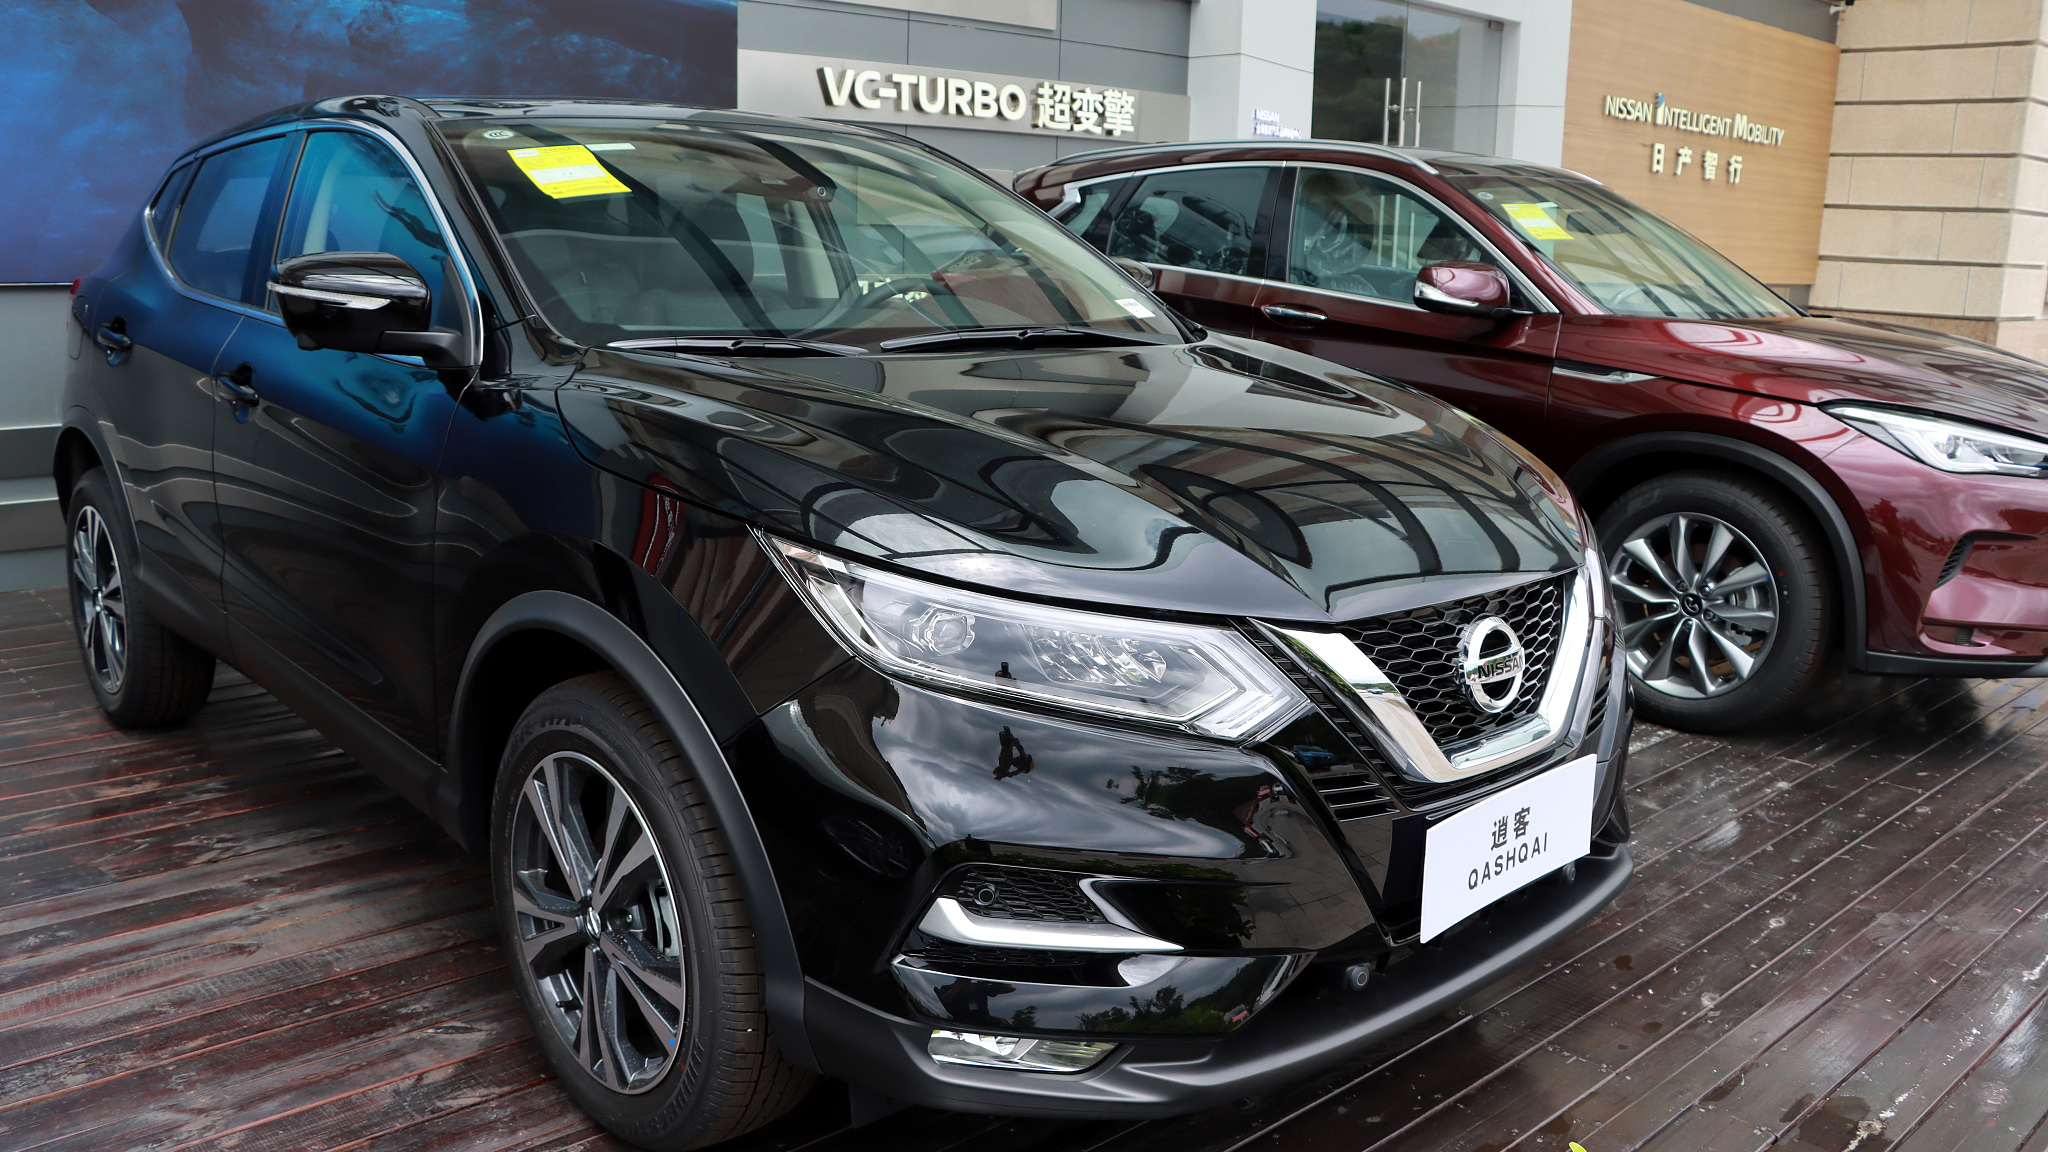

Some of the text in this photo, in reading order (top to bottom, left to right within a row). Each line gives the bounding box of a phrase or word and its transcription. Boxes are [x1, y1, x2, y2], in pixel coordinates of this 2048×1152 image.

[817, 66, 1136, 137] VC-TURBO 超变擎
[1255, 109, 1280, 122] NISSAN
[1604, 95, 1653, 123] NISSAN
[1651, 142, 1743, 184] 日产智行
[1477, 654, 1524, 679] NISSAN
[1490, 806, 1531, 851] 逍客
[1467, 832, 1548, 890] QASHQAI
